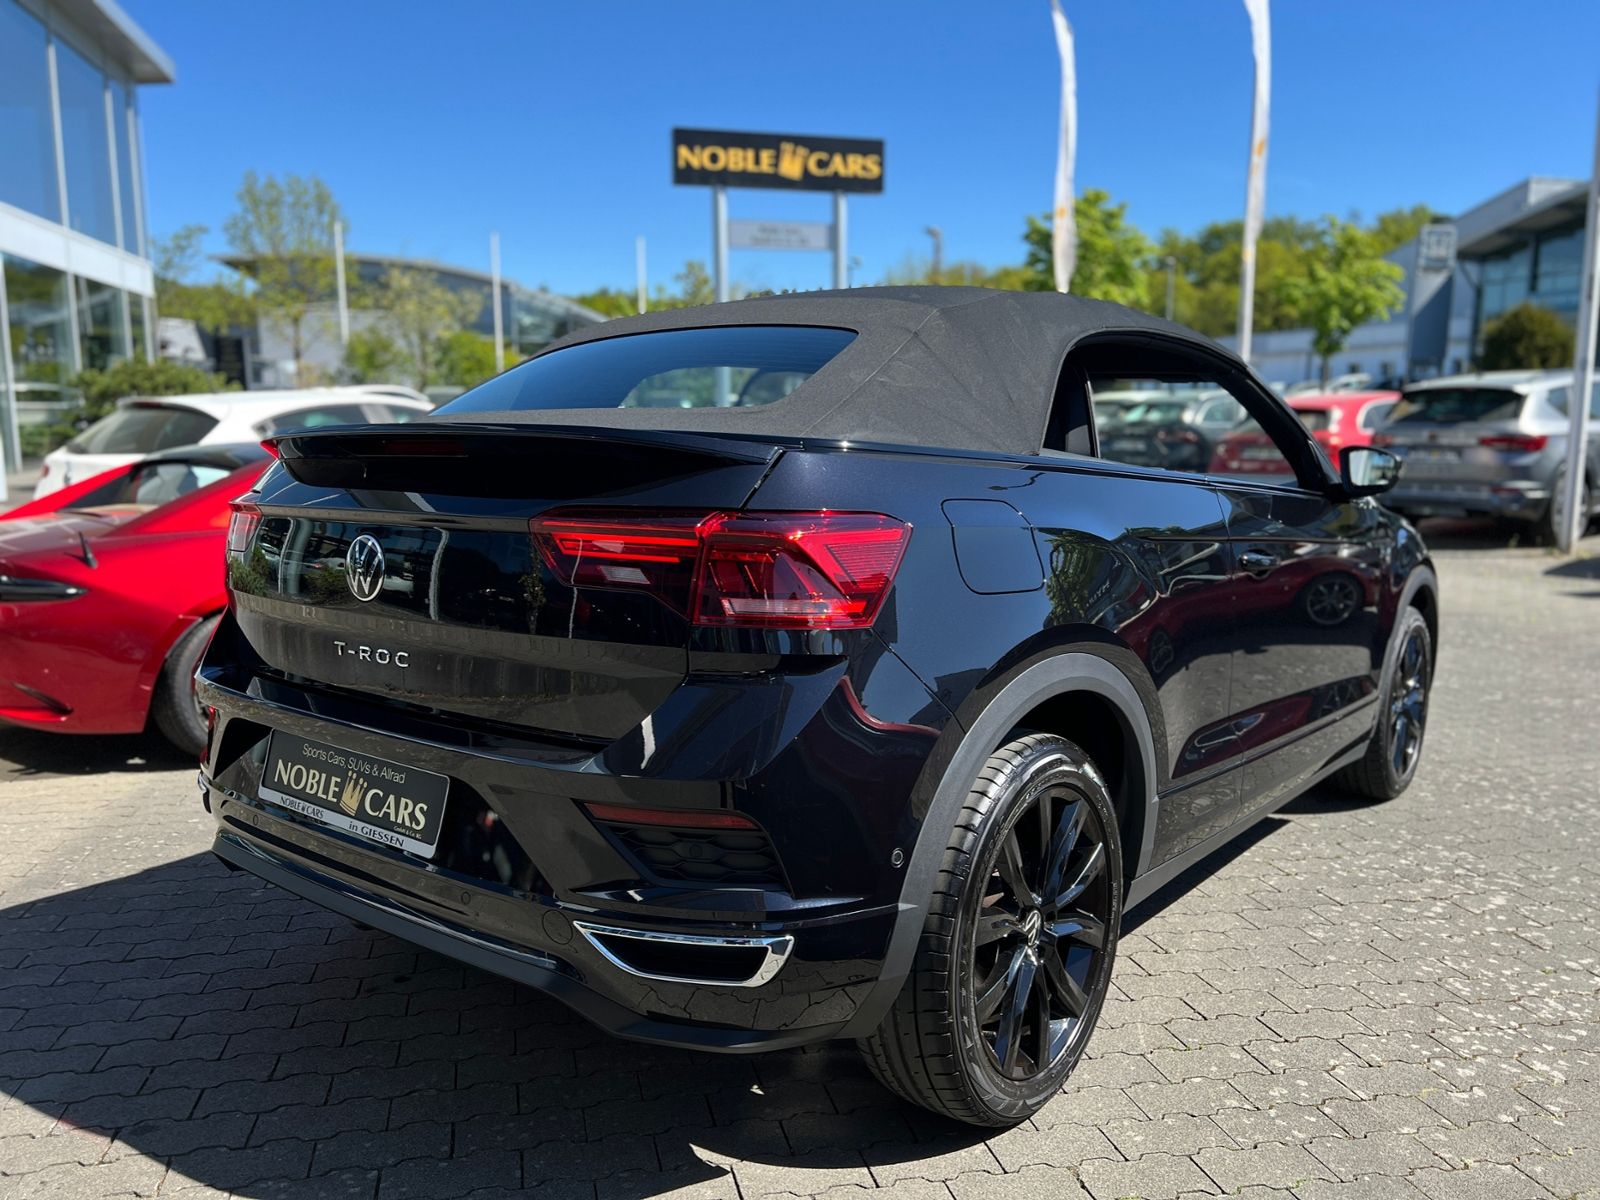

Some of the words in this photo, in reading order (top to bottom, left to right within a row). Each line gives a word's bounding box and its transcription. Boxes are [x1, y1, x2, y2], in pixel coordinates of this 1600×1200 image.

[676, 144, 776, 173] NOBLE
[807, 150, 881, 179] CARS
[334, 640, 409, 667] T-ROC
[302, 743, 327, 761] Sports
[327, 751, 347, 768] Cars,
[371, 764, 379, 777] &
[379, 766, 406, 784] Allrad
[274, 759, 342, 803] NOBLE
[364, 788, 428, 831] CARS
[280, 796, 302, 812] NOBLE
[306, 807, 324, 819] CARS
[348, 821, 358, 832] in
[361, 826, 405, 847] GIESSEN
